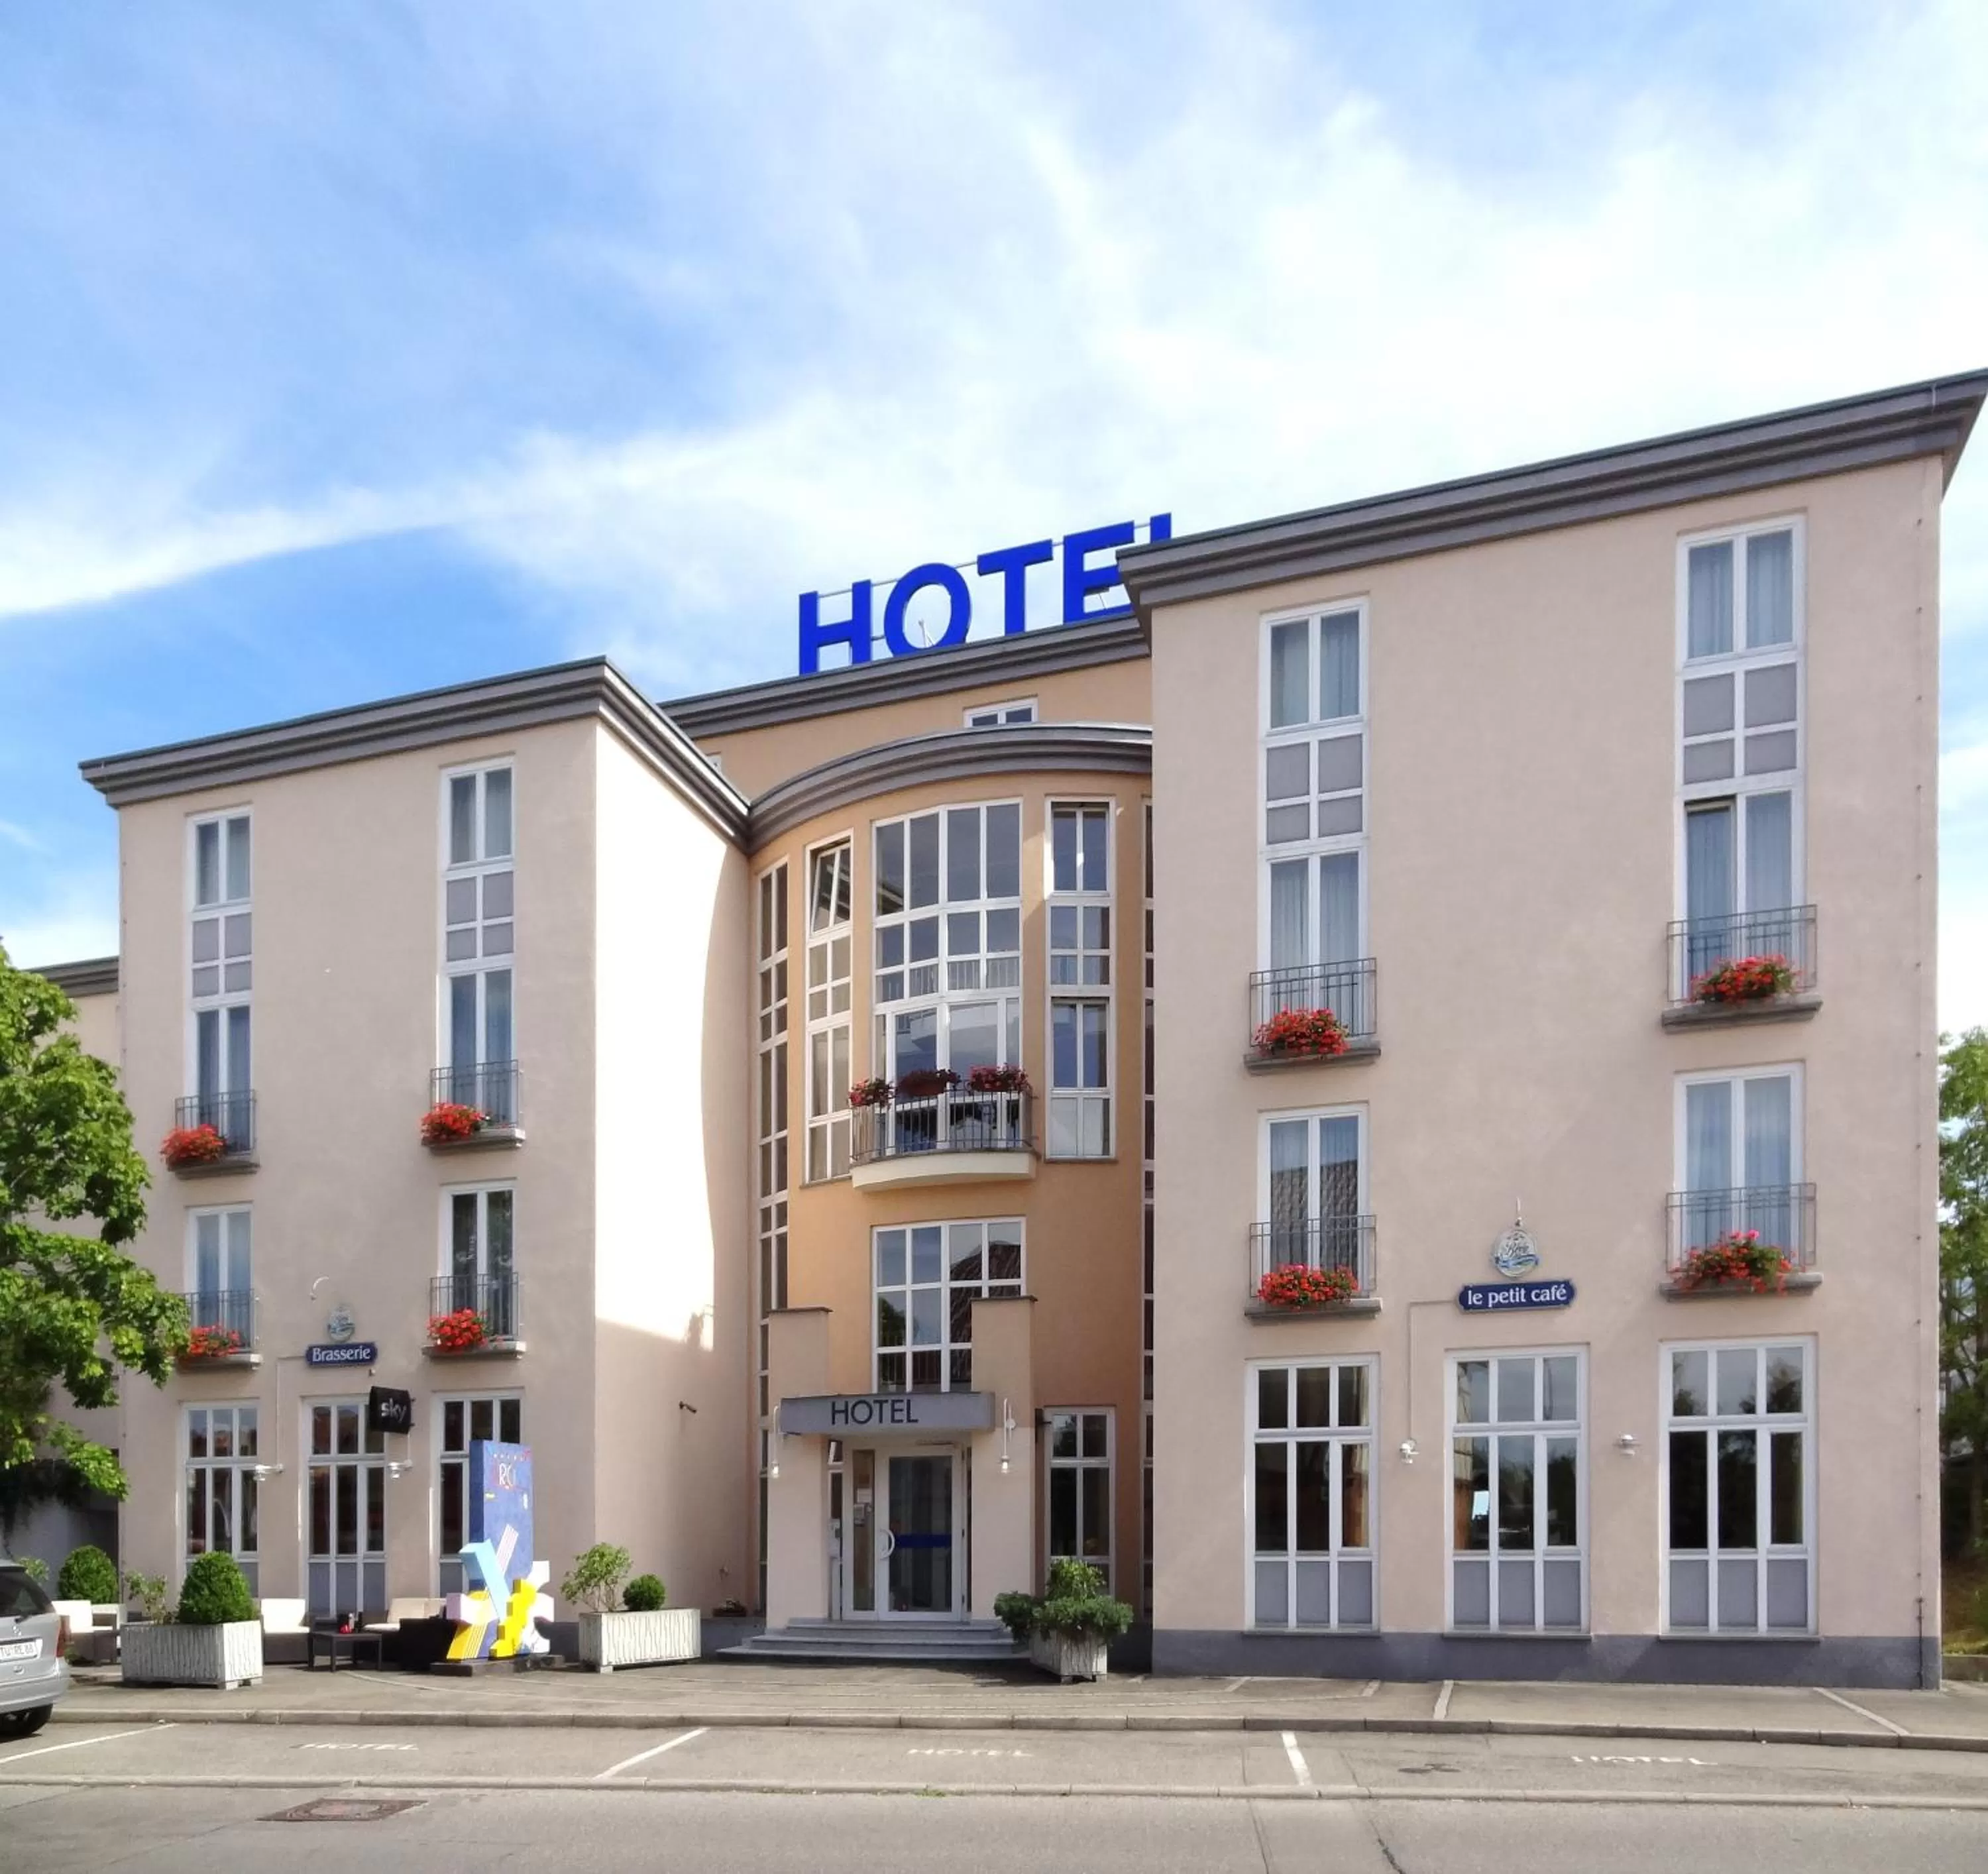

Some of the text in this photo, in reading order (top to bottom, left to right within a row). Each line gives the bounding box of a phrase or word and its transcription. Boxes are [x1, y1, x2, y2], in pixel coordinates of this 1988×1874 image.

[799, 512, 1172, 677] HOTE
[1468, 1284, 1567, 1307] le petit café
[312, 1345, 372, 1362] Brasserie
[381, 1397, 407, 1423] sky
[831, 1399, 919, 1425] HOTEL
